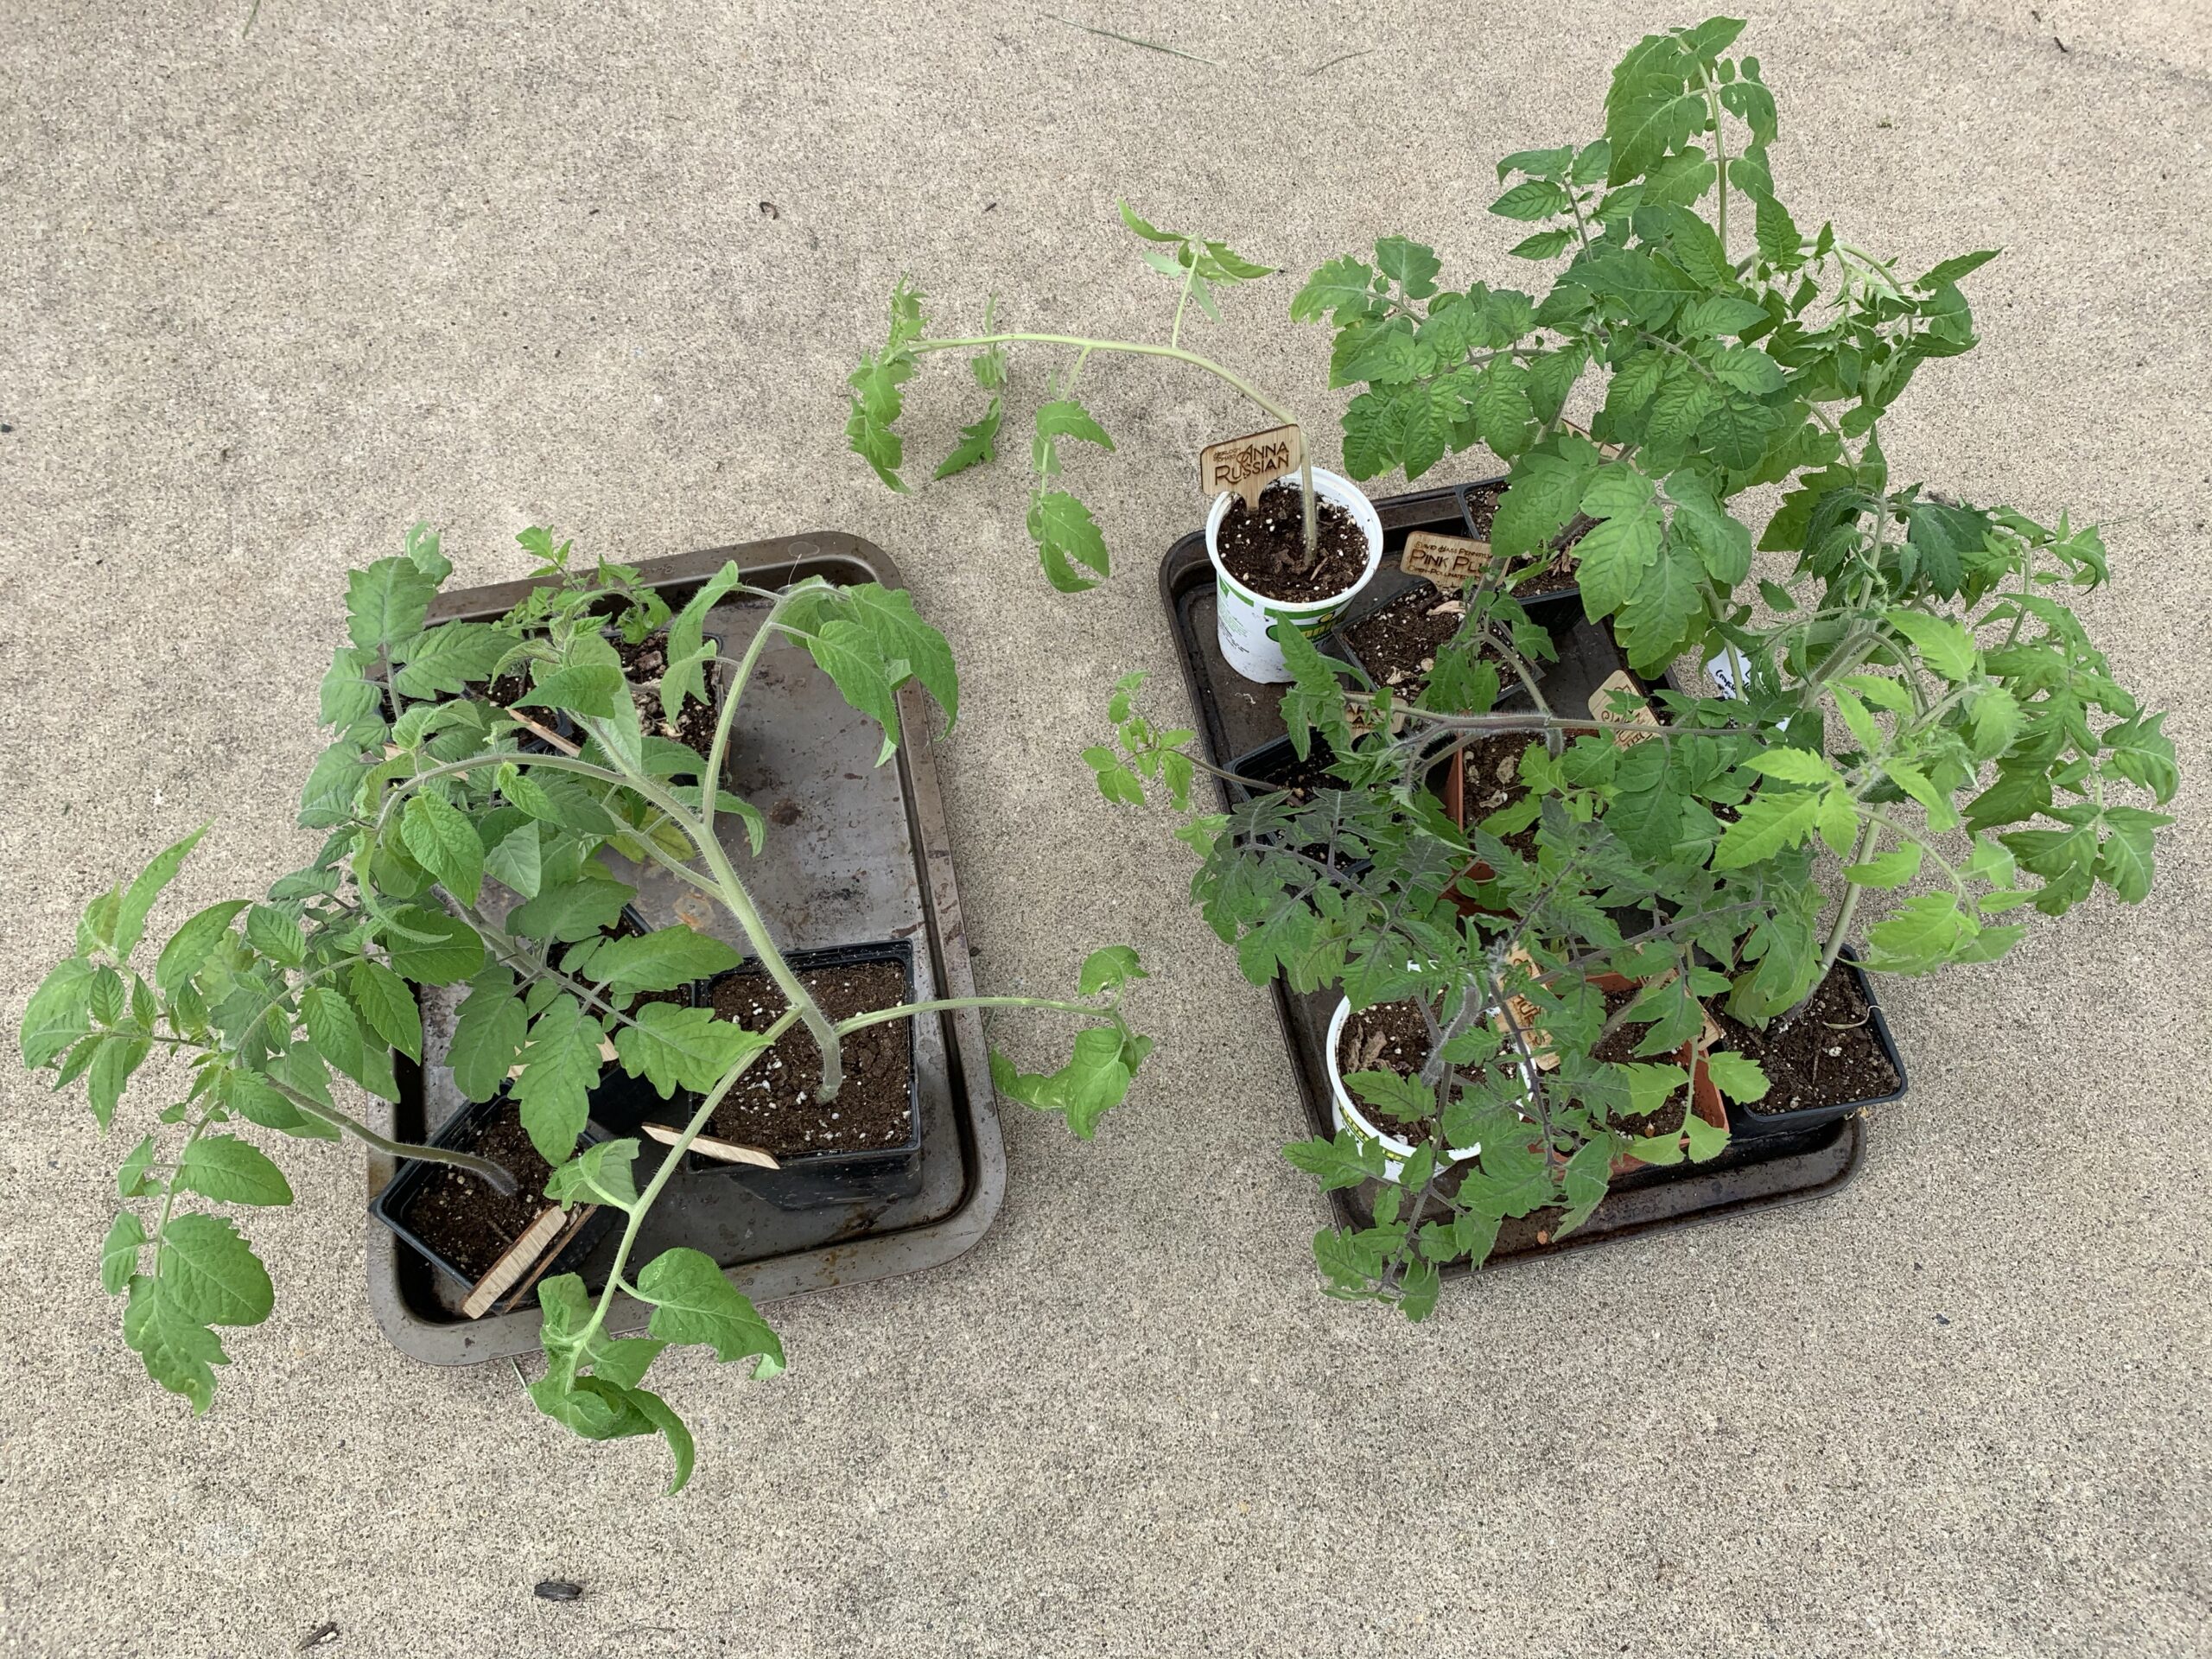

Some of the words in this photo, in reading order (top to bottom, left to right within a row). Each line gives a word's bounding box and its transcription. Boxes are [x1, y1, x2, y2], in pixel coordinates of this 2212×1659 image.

[1215, 454, 1290, 486] RUSSIAN
[1236, 441, 1290, 471] ANNA
[1409, 549, 1450, 569] PINK
